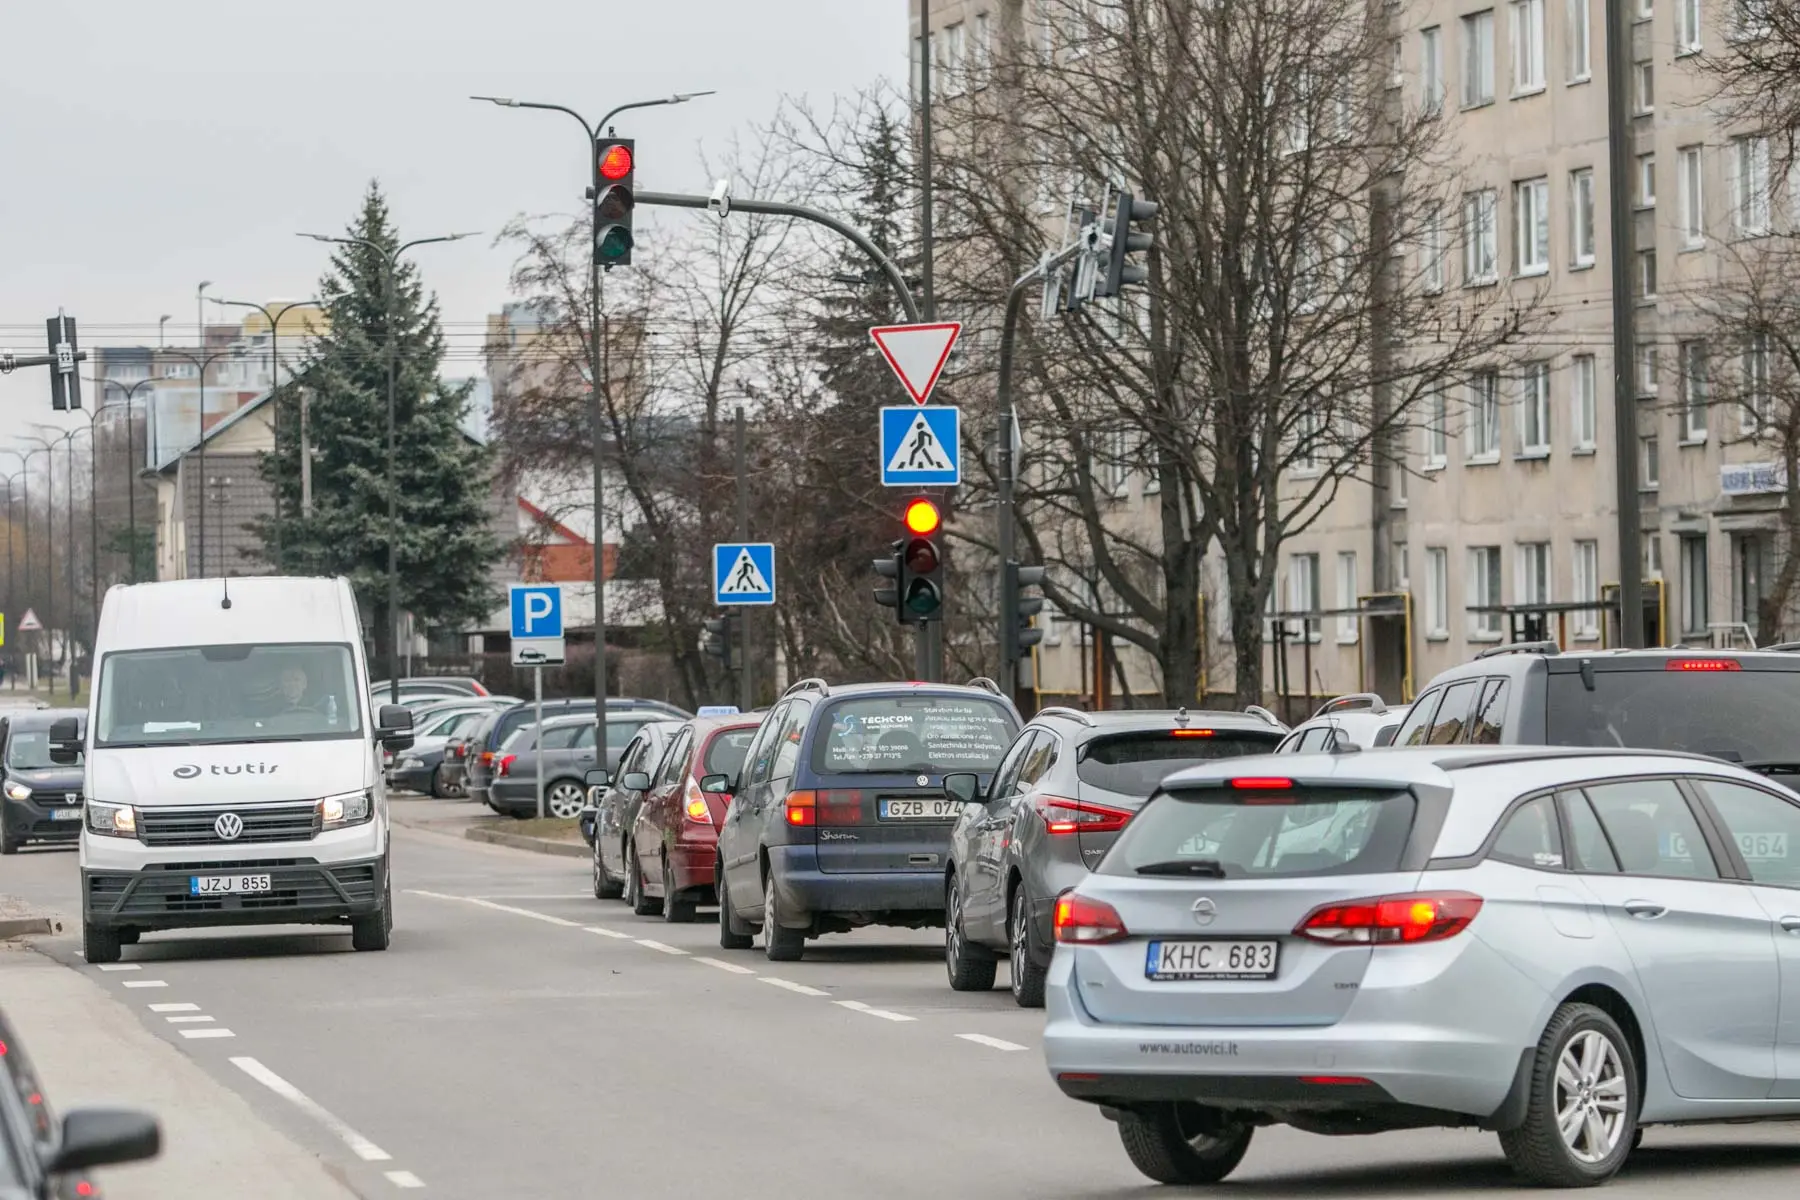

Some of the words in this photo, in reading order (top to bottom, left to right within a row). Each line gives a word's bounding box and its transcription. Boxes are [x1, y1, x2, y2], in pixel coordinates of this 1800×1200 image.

[524, 591, 553, 633] P
[211, 762, 279, 775] tutis
[890, 801, 923, 816] GZB
[820, 830, 859, 840] Sharan
[1741, 835, 1784, 856] 964
[201, 878, 232, 891] JZJ
[241, 876, 269, 890] 855
[1162, 945, 1212, 969] KHC
[1229, 945, 1272, 969] 683
[1139, 1041, 1238, 1056] www.autovici.lt
